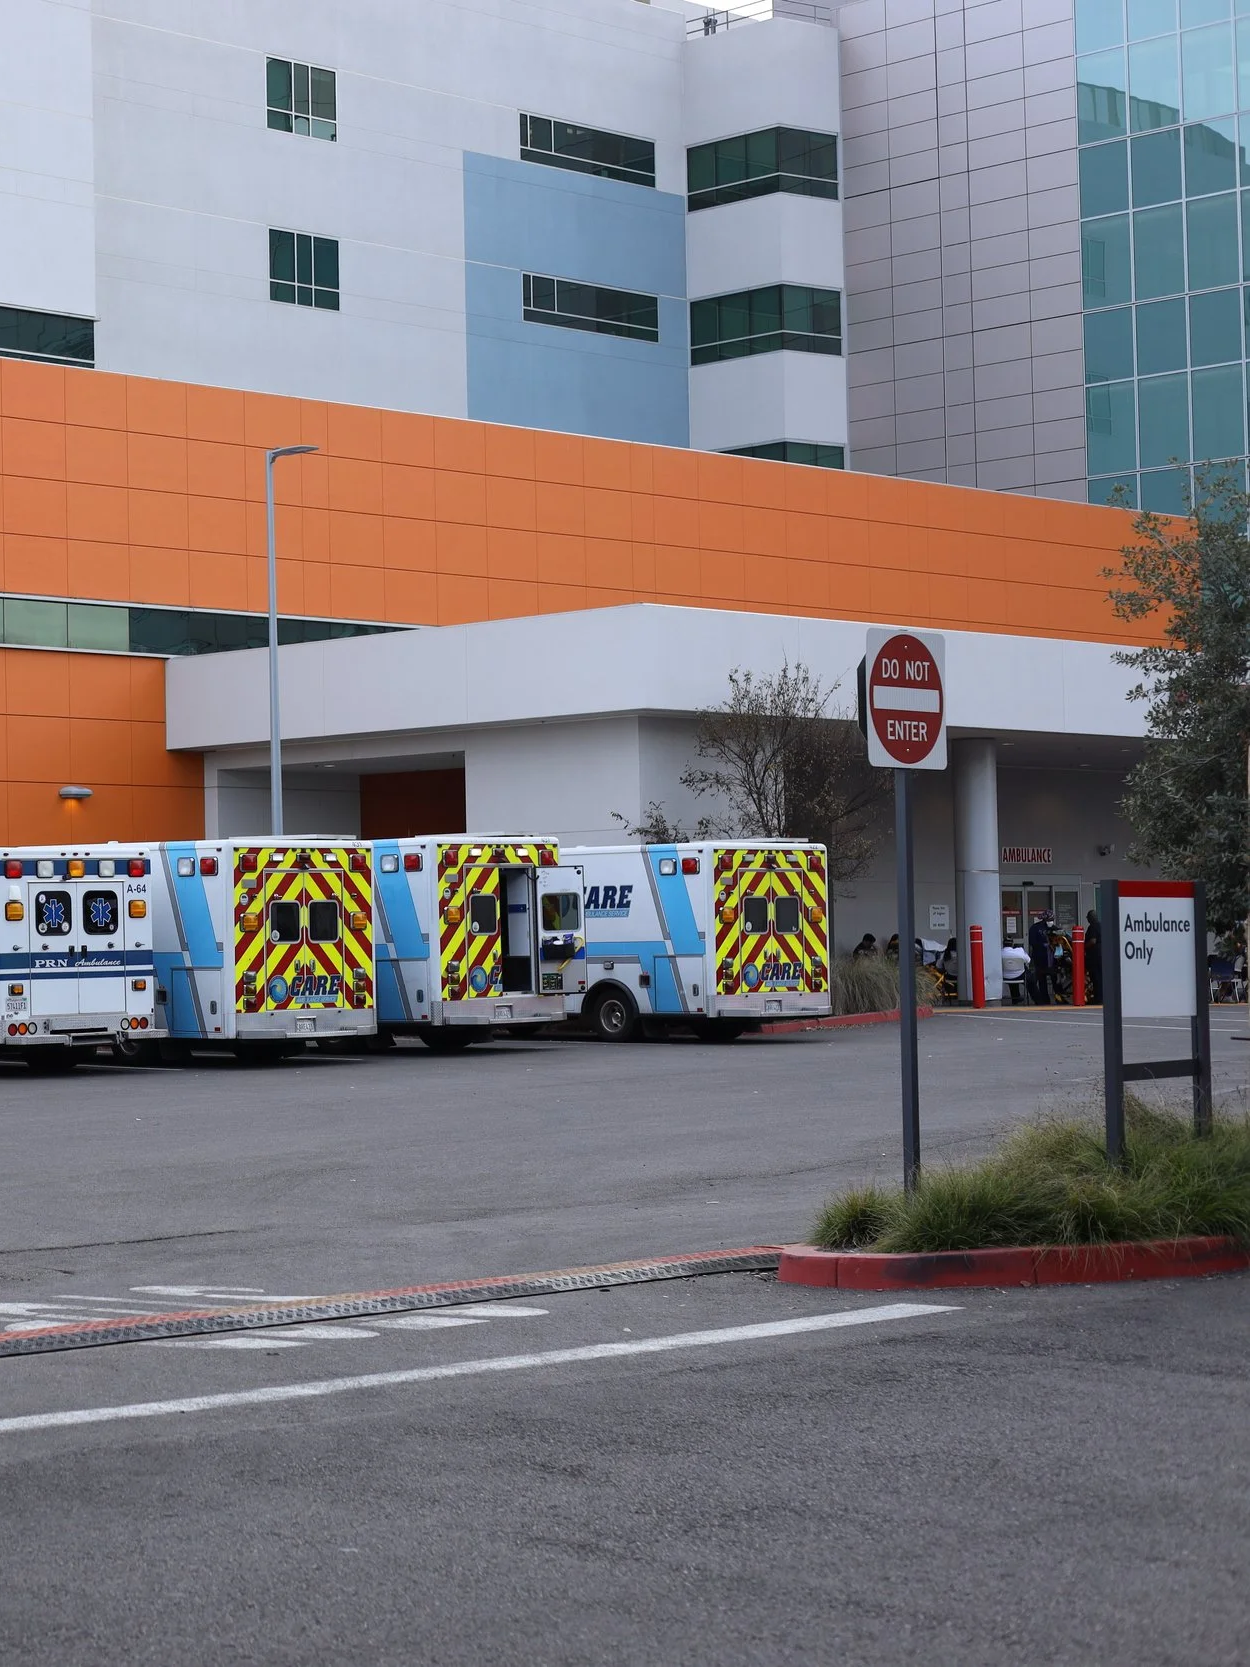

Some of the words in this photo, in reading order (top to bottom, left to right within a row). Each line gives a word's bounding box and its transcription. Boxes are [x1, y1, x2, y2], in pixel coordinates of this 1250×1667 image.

[882, 658, 899, 679] DO
[905, 660, 930, 681] NOT
[887, 719, 928, 742] ENTER
[1002, 847, 1052, 863] AMBULANCE
[127, 884, 146, 893] A-64
[584, 885, 633, 909] ARE
[1123, 912, 1190, 932] Ambulance
[1125, 939, 1153, 965] Only
[35, 959, 68, 968] PRN
[75, 958, 121, 967] Ambulance
[760, 962, 802, 981] CARE
[290, 974, 342, 997] CARE
